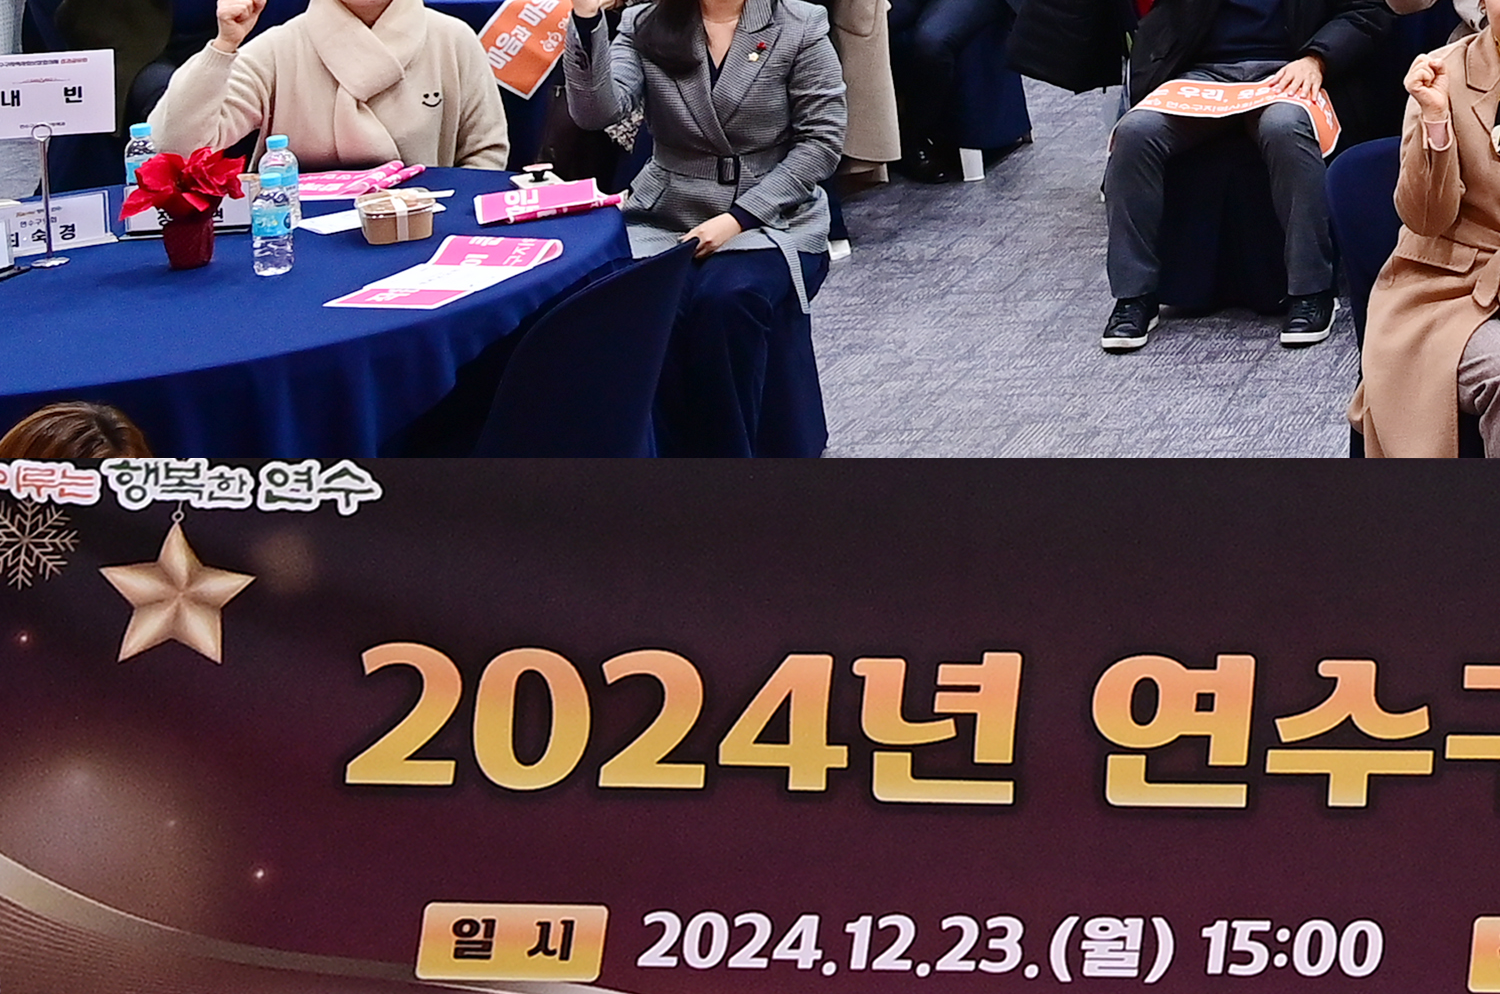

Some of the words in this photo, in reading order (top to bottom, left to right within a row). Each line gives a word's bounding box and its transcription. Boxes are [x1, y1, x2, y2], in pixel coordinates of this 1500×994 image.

[107, 460, 249, 504] 행복한
[263, 465, 377, 508] 연수
[345, 642, 1023, 805] 2024년
[637, 911, 1174, 984] 2024.12.23.(월)
[1201, 918, 1384, 978] 15:00
